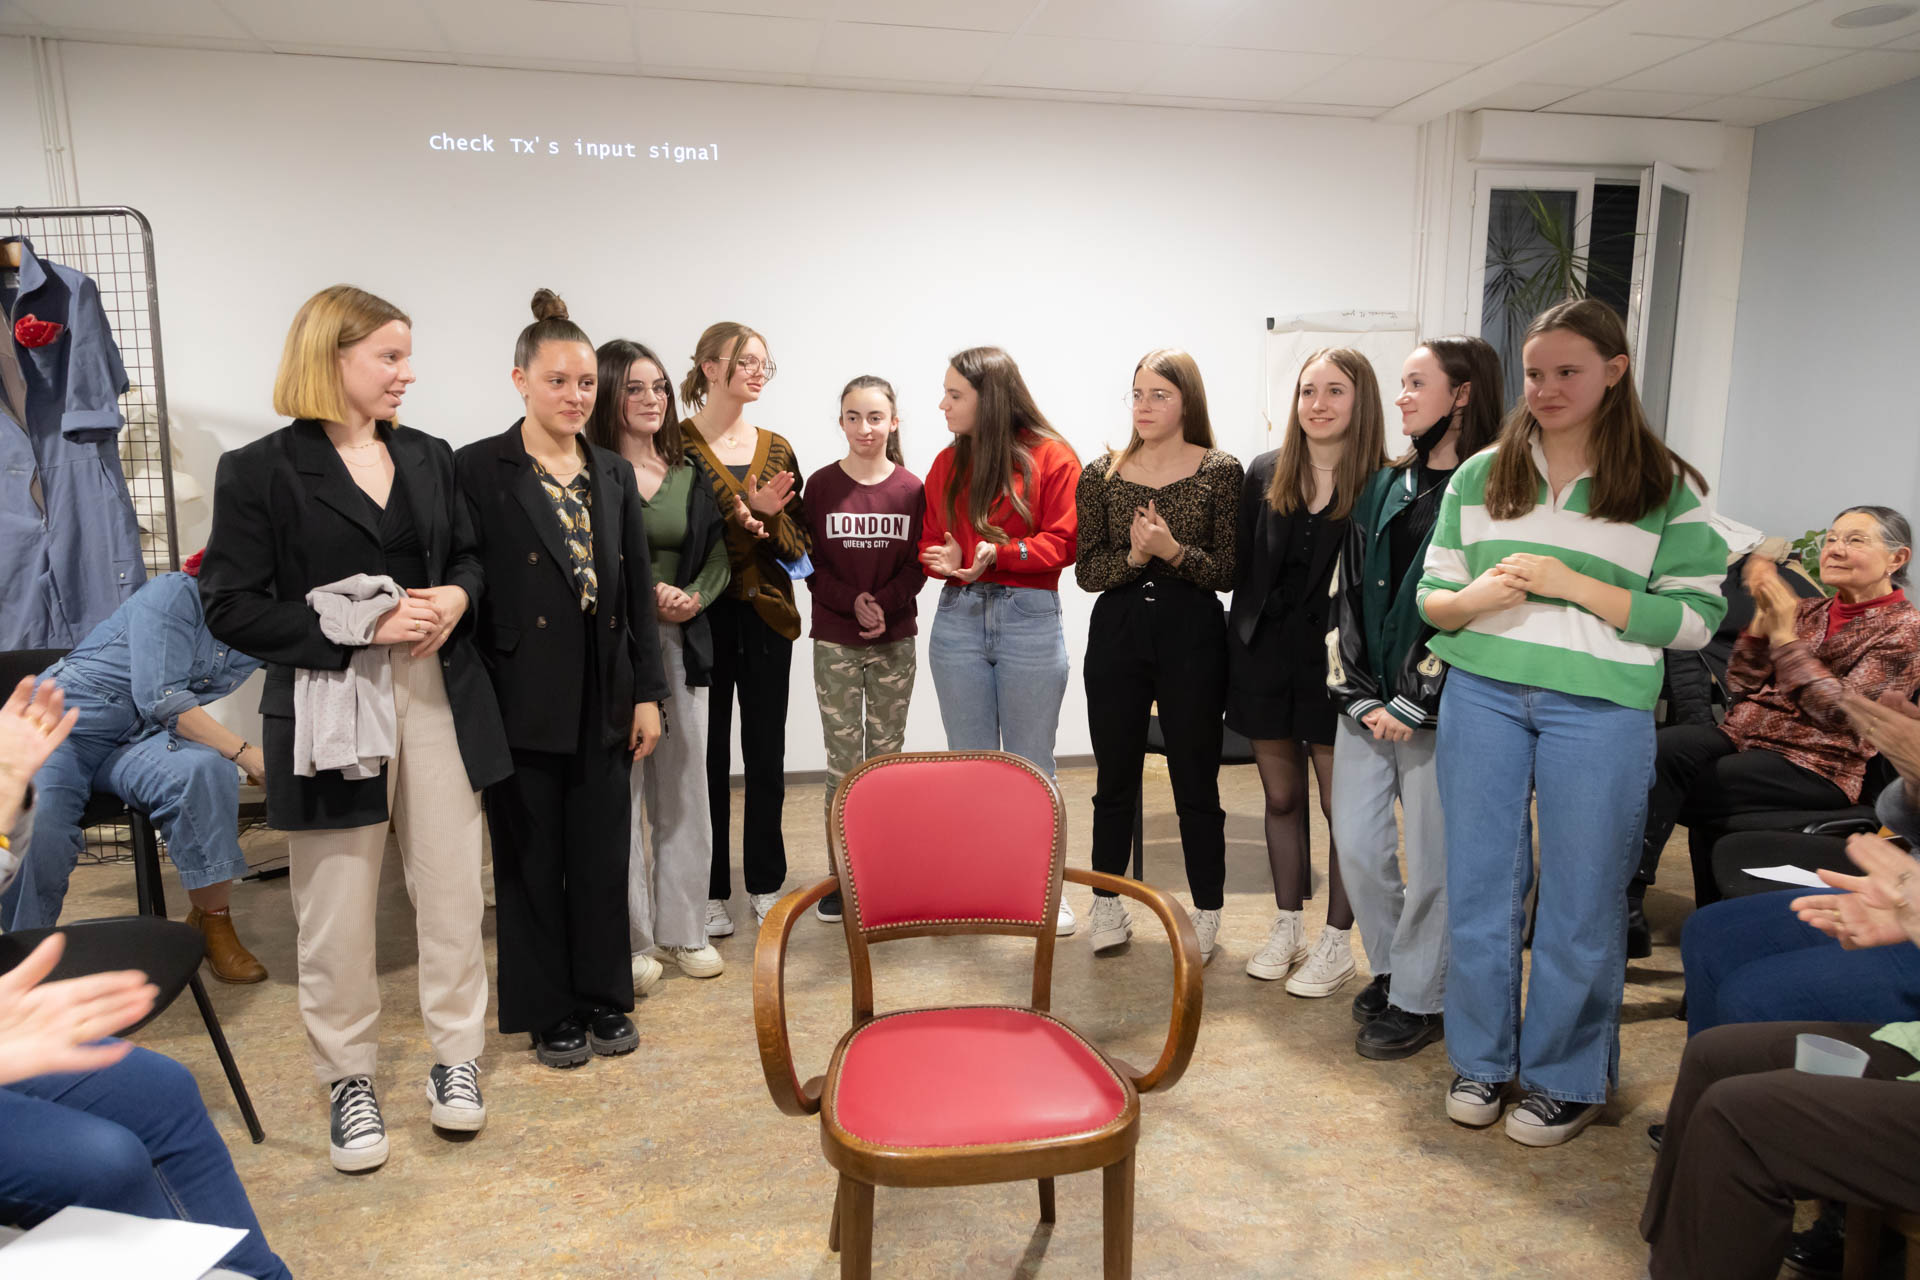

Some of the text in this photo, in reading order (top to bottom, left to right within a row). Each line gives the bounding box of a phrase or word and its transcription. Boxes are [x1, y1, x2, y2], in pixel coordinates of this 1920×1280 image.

[429, 131, 495, 153] Check
[574, 138, 636, 160] input
[649, 142, 718, 163] signal
[831, 515, 904, 537] LONDON
[842, 540, 890, 549] QUEEN'S CITY
